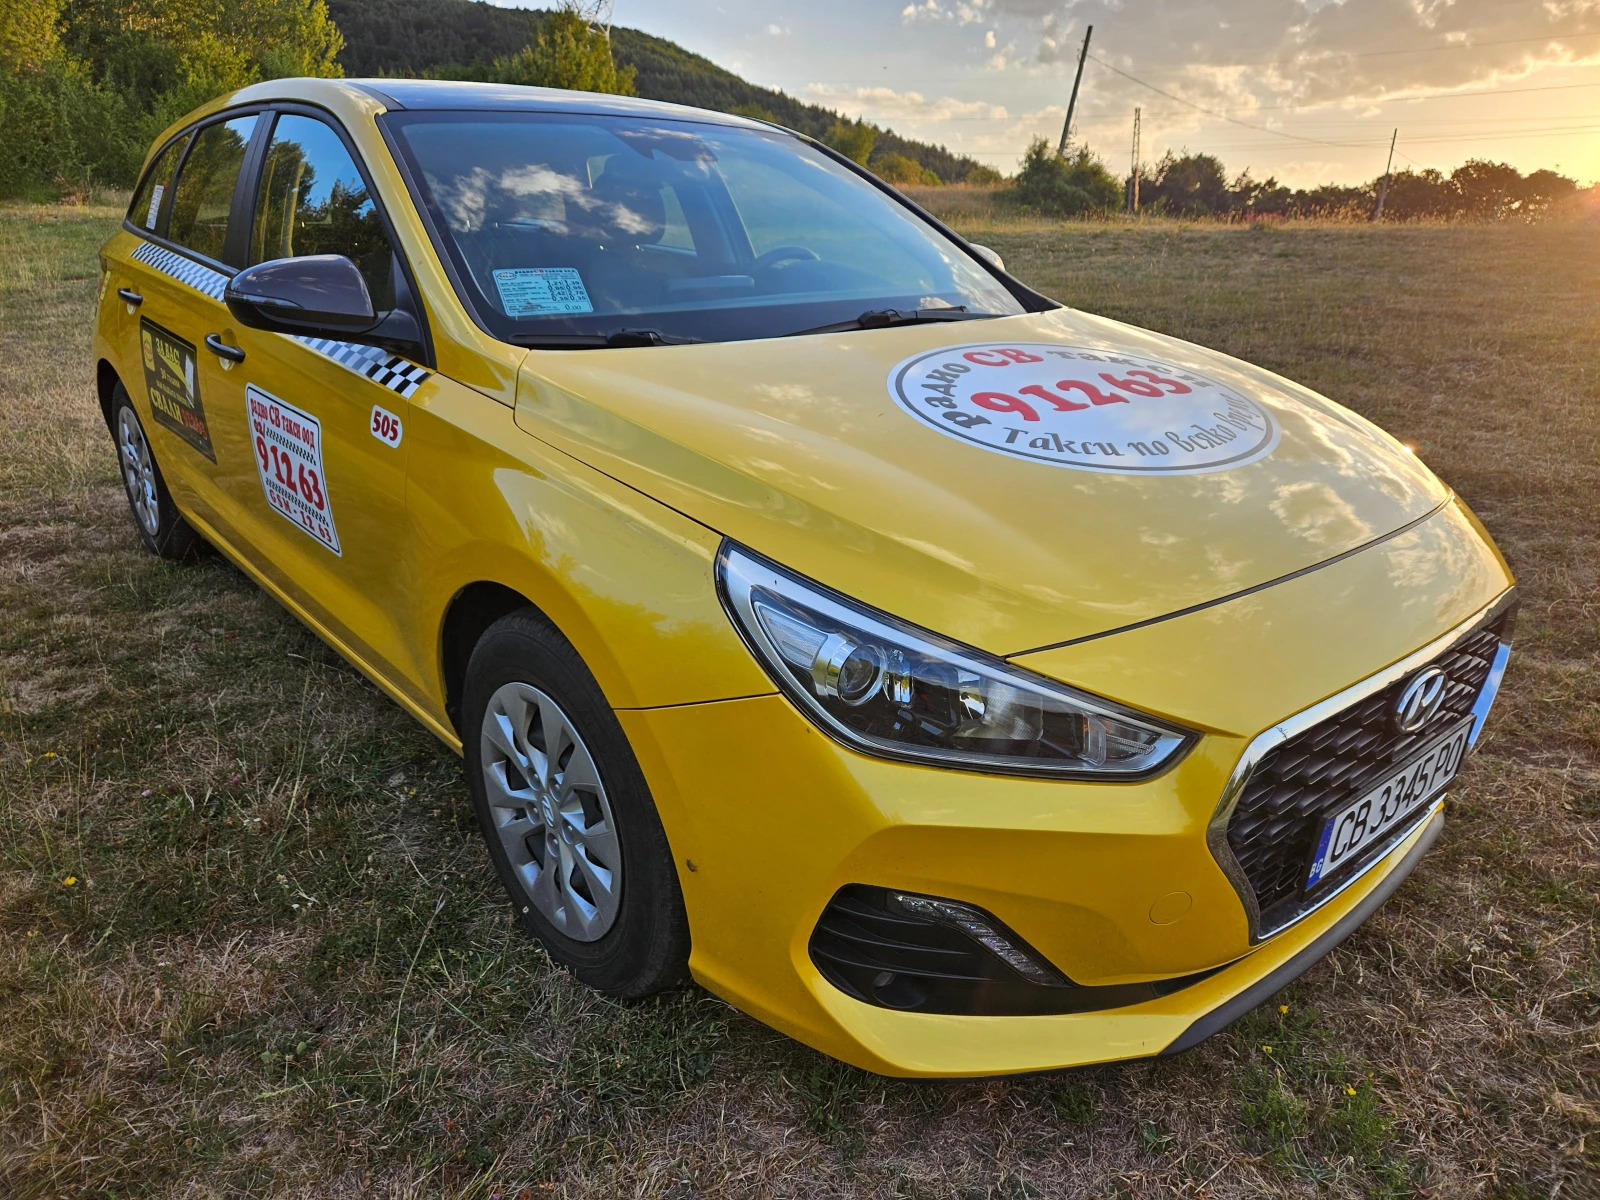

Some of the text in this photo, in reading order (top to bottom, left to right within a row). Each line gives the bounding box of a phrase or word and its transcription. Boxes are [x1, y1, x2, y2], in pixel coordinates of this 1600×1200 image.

[962, 348, 1044, 367] СВ
[269, 404, 280, 428] СВ
[281, 415, 301, 440] такси
[372, 410, 399, 442] 505
[1002, 427, 1125, 457] Такси
[1127, 441, 1170, 456] по
[1164, 424, 1237, 453] всяко
[269, 489, 292, 514] GSM
[1330, 799, 1372, 863] CB
[1369, 753, 1436, 836] 3345
[1309, 857, 1324, 878] BG
